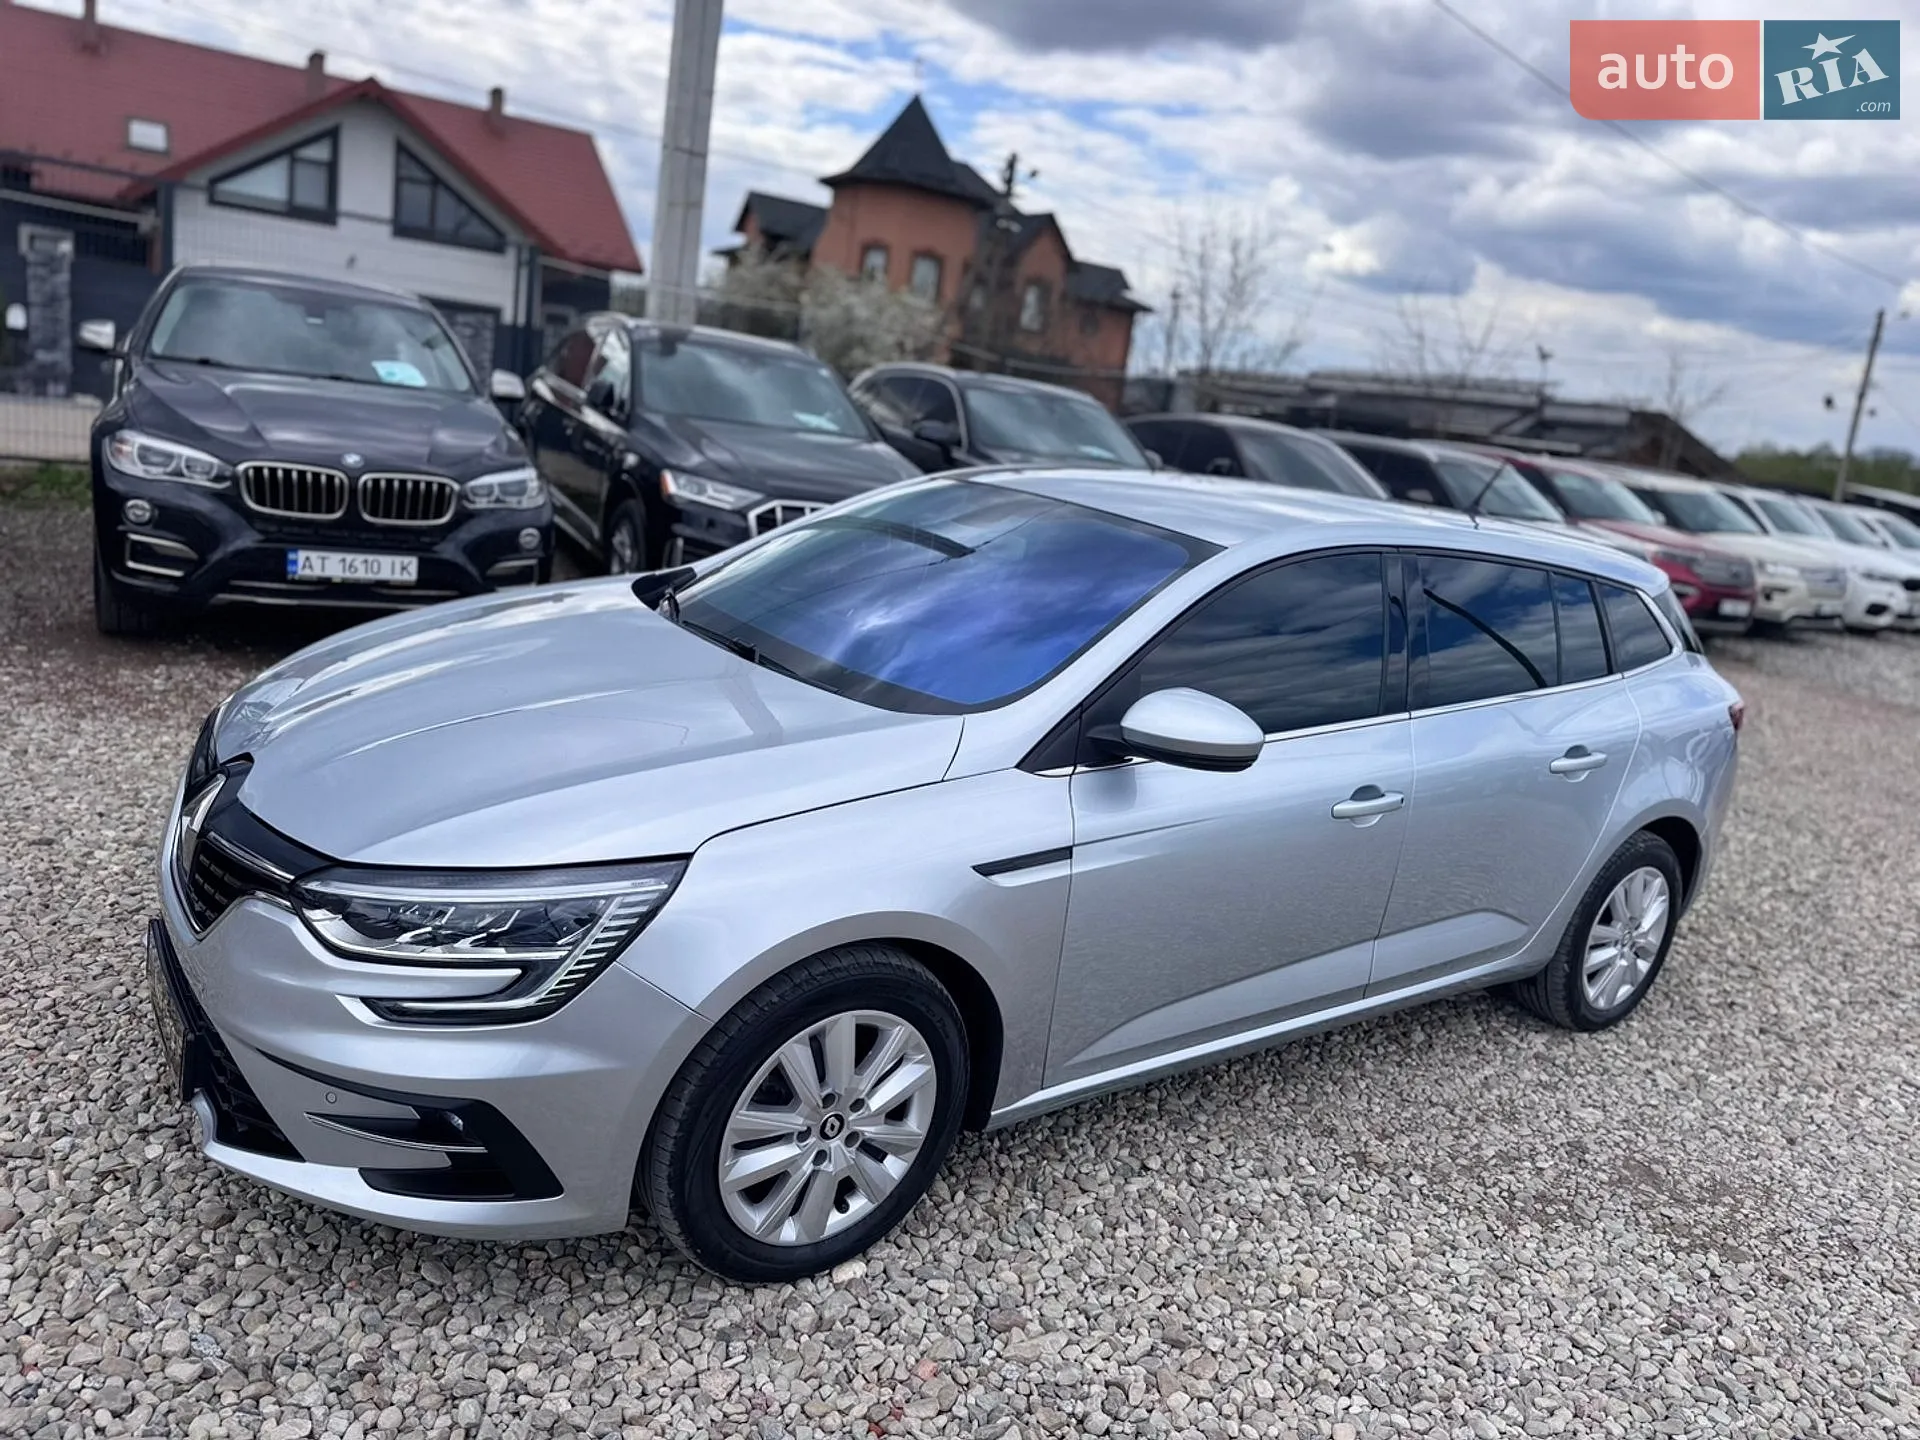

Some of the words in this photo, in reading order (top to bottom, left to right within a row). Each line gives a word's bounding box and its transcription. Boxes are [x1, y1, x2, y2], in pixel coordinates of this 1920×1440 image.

[301, 555, 331, 573] AT
[338, 556, 382, 575] 1610
[391, 559, 414, 577] IK
